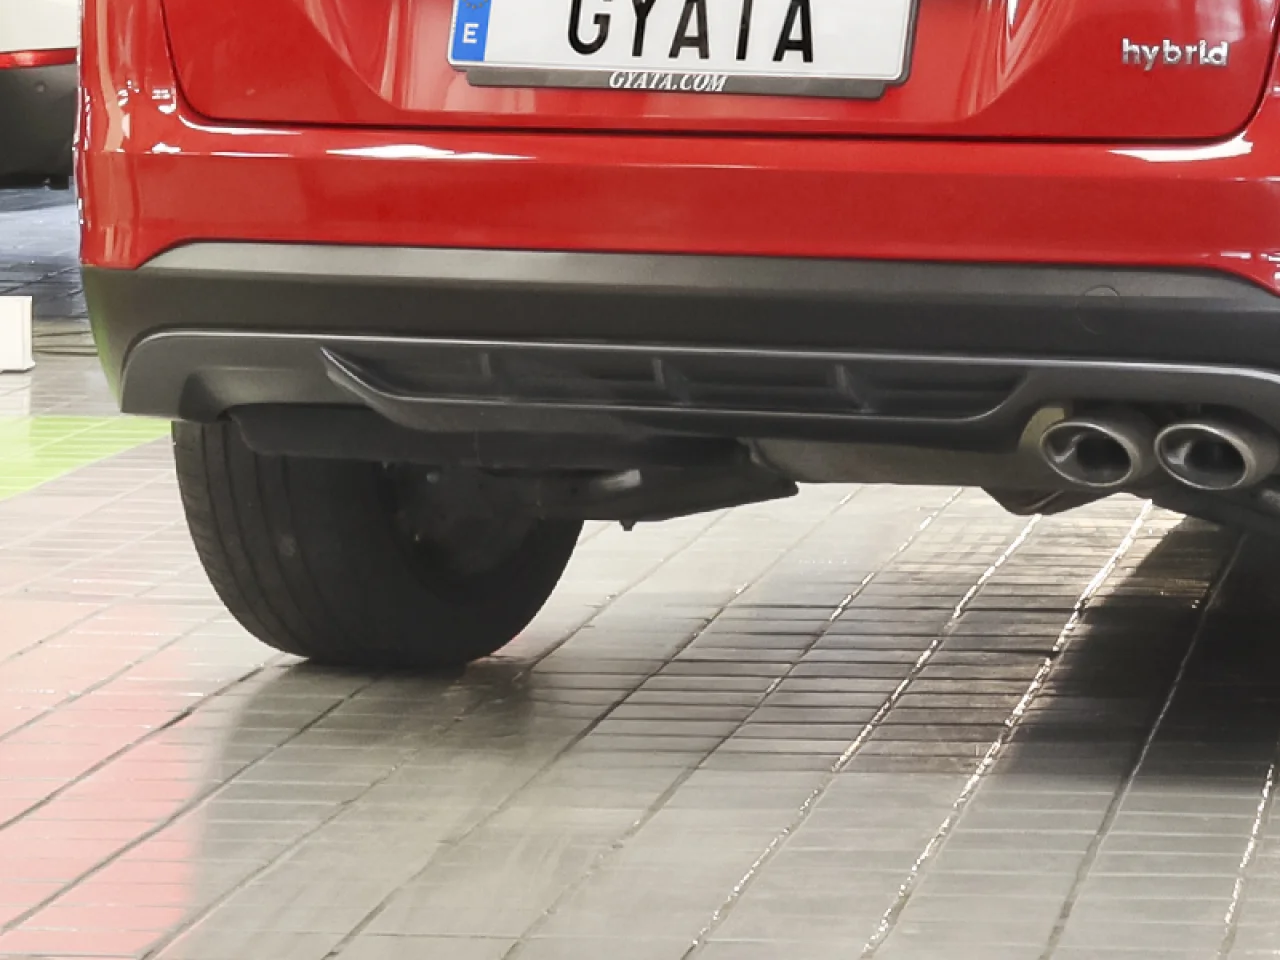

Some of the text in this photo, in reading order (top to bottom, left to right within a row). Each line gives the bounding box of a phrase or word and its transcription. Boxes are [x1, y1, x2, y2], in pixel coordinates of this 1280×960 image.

[462, 22, 480, 44] E
[1122, 38, 1229, 70] hybrid
[609, 71, 729, 92] GYATA.COM
